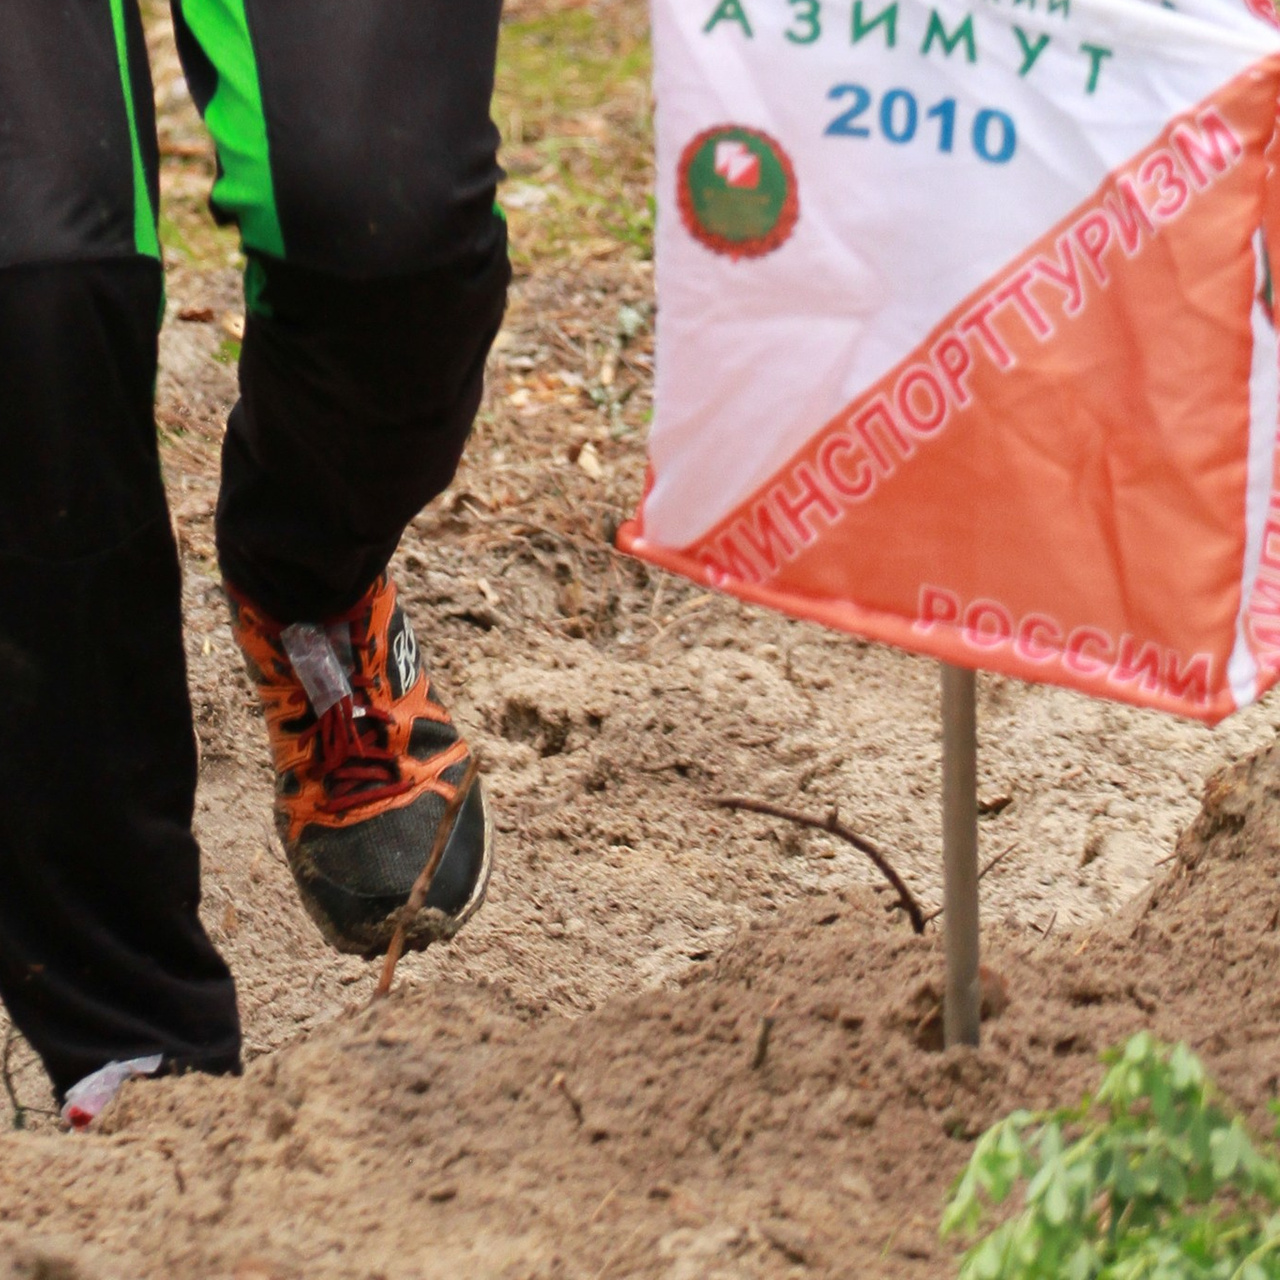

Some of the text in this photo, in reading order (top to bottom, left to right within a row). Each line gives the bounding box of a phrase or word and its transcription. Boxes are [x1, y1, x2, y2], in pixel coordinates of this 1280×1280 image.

[824, 82, 1019, 166] 2010
[696, 104, 1244, 587] МИНСПОРТТУРИЗМ
[913, 583, 1218, 706] РОССИИ
